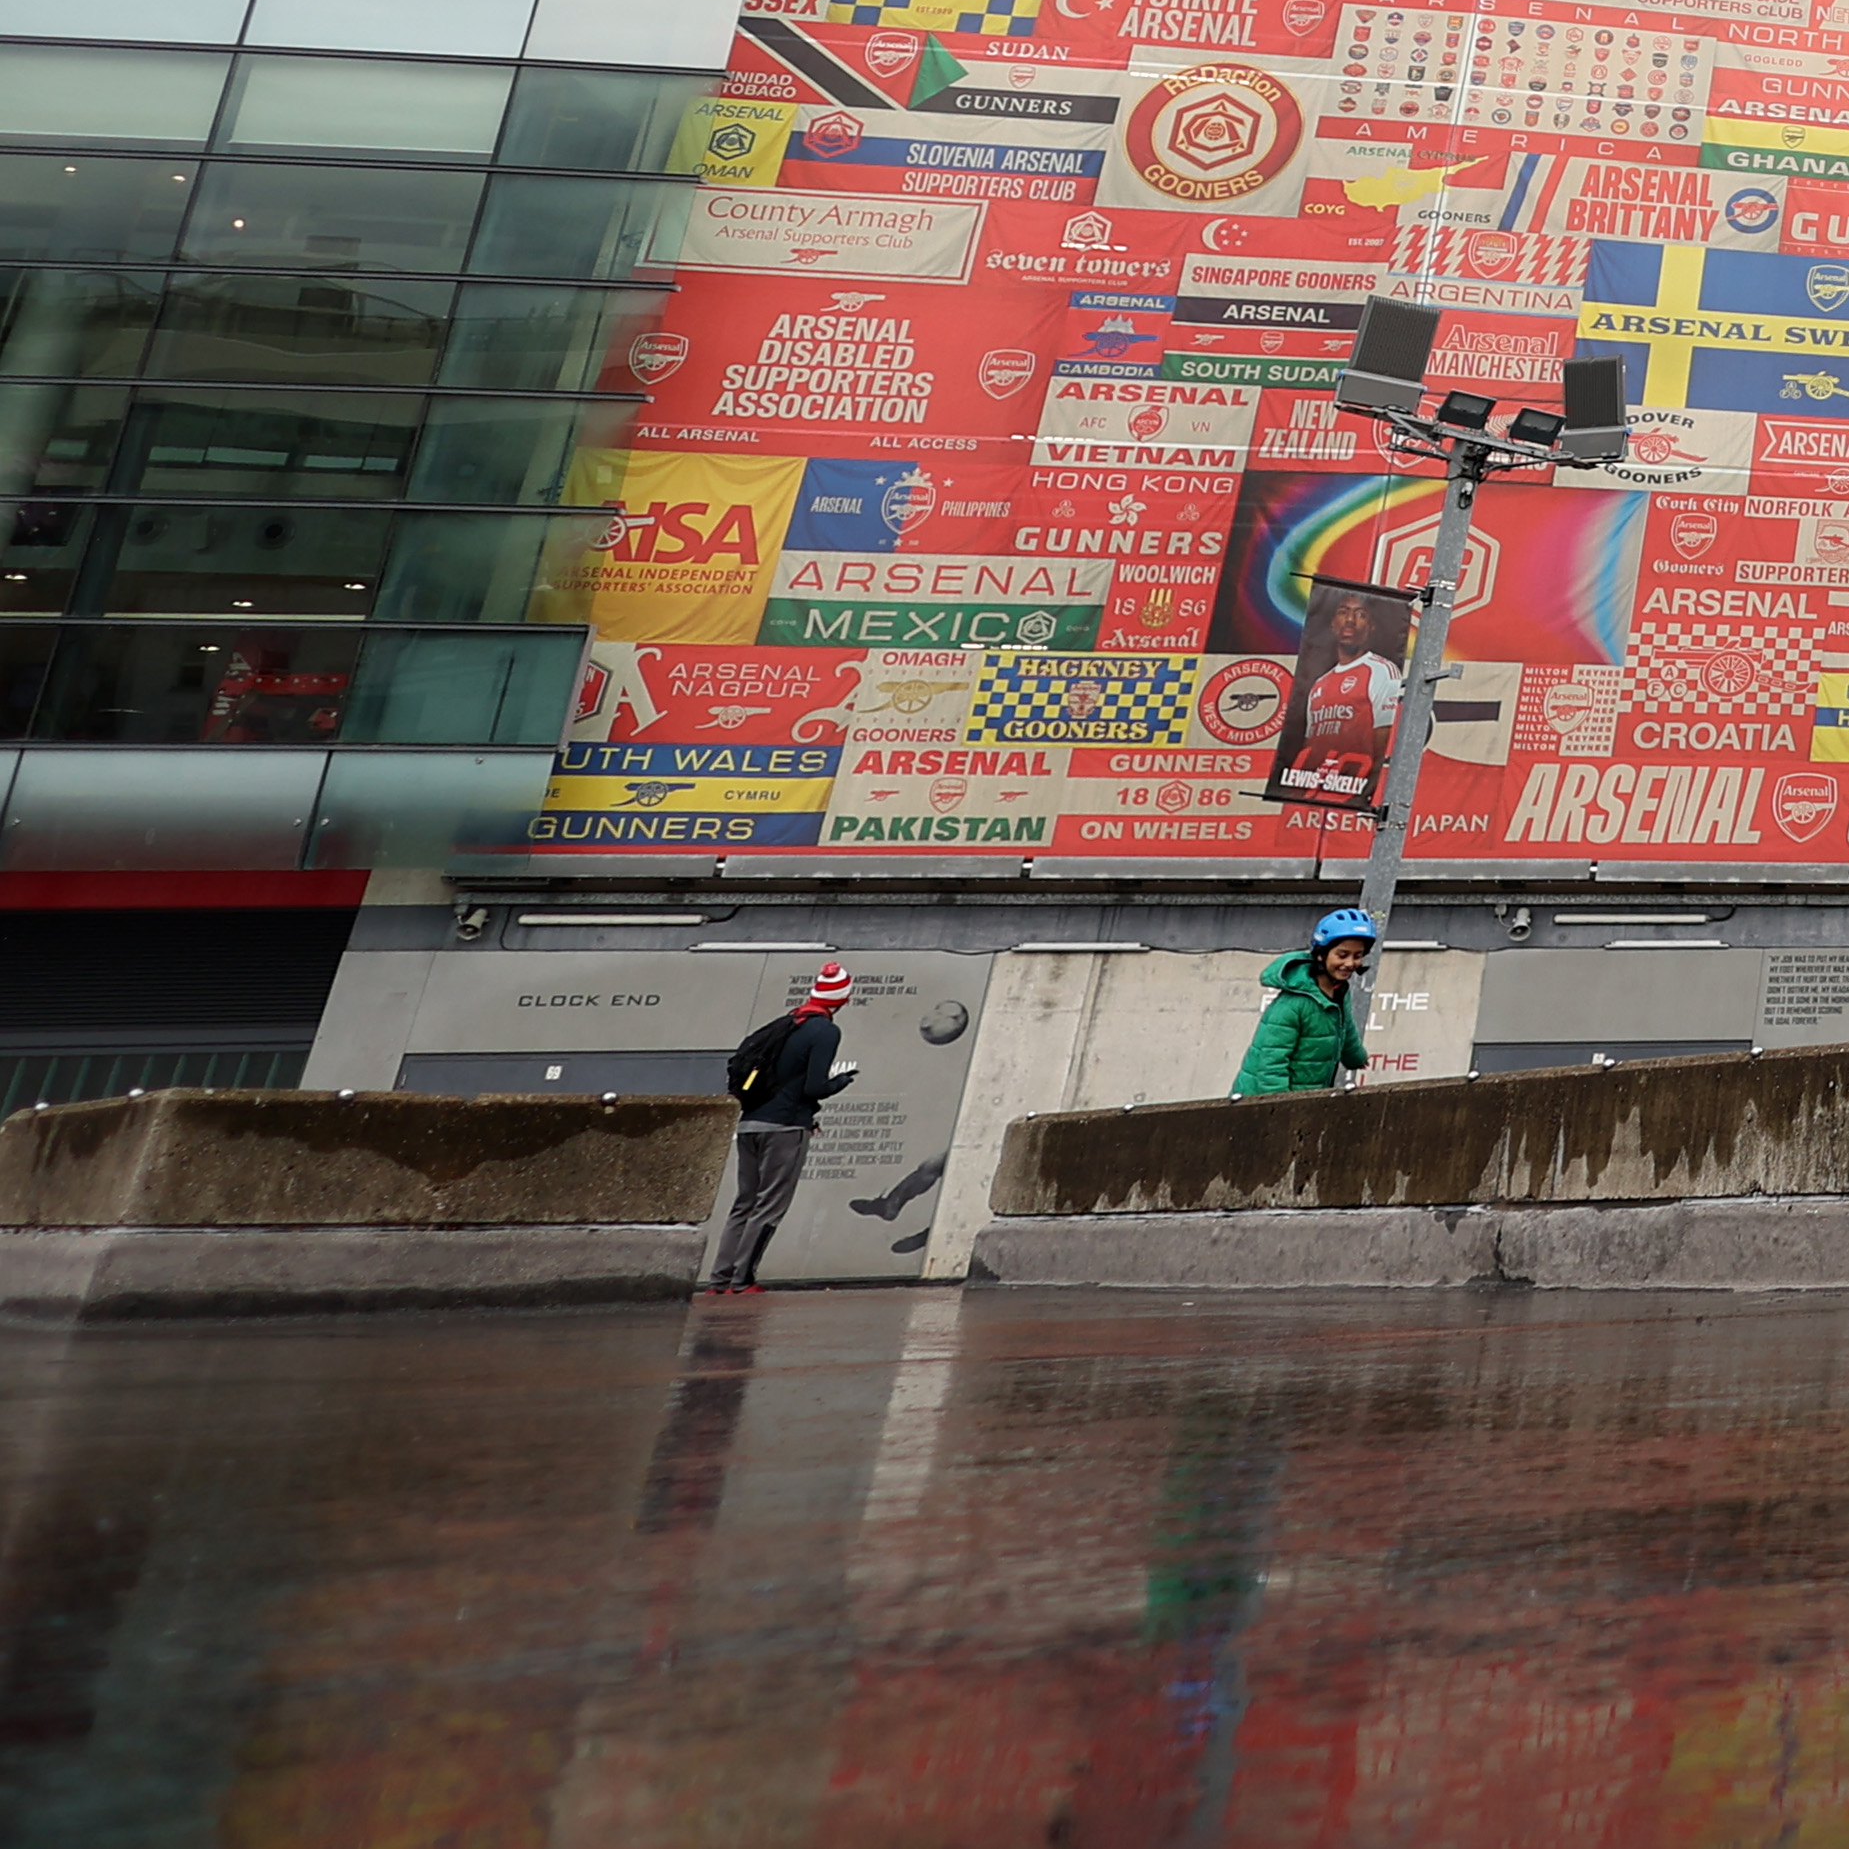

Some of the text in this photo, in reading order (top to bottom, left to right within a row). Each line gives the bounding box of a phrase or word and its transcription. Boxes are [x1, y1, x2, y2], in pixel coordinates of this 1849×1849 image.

[1756, 3, 1804, 19] CLUB
[1118, 10, 1257, 48] ARSENAL
[906, 144, 1084, 174] SLOVENIA ARSENAL
[902, 173, 1076, 201] SUPPORTERS CLUB
[1580, 165, 1713, 207] ARSENAL
[707, 196, 933, 232] County Armagh
[1566, 198, 1720, 241] BRITTANY
[715, 225, 913, 249] Arsenal Supporters Club
[1390, 281, 1573, 311] ARGENTINA
[1223, 304, 1330, 323] ARSENAL
[768, 315, 915, 343] ARSENAL
[1590, 313, 1771, 342] ARSENAL
[757, 340, 915, 370] DISABLED
[722, 365, 934, 397] SUPPORTERS
[1055, 382, 1250, 406] ARSENAL
[712, 392, 928, 422] ASSOCIATION
[638, 427, 978, 451] ALL ARSENAL ALL ACCESS
[1047, 444, 1234, 467] VIETNAM
[1032, 472, 1235, 494] HONG KONG
[1747, 500, 1834, 520] NORFOLK
[1014, 527, 1223, 555] GUNNERS
[638, 568, 756, 582] INDEPENDENT
[788, 561, 1093, 597] ARSENAL
[1119, 563, 1216, 584] WOOLWICH
[1642, 589, 1818, 620] ARSENAL
[882, 651, 966, 666] OMAGH
[667, 663, 821, 682] ARSENAL
[673, 680, 812, 698] NAGPUR
[852, 728, 956, 743] GOONERS
[1634, 723, 1795, 751] CROATIA
[852, 750, 1052, 776] ARSENAL
[1110, 754, 1252, 773] GUNNERS
[1280, 768, 1368, 794] LEWIS-SKELLY
[1504, 763, 1766, 844] ARSENAL
[528, 816, 755, 840] GUNNERS
[830, 816, 1046, 841] PAKISTAN
[1081, 822, 1252, 840] ON WHEELS
[518, 993, 661, 1009] CLOCK END
[1378, 993, 1430, 1010] THE
[545, 1065, 561, 1081] 69
[1371, 1053, 1420, 1071] THE
